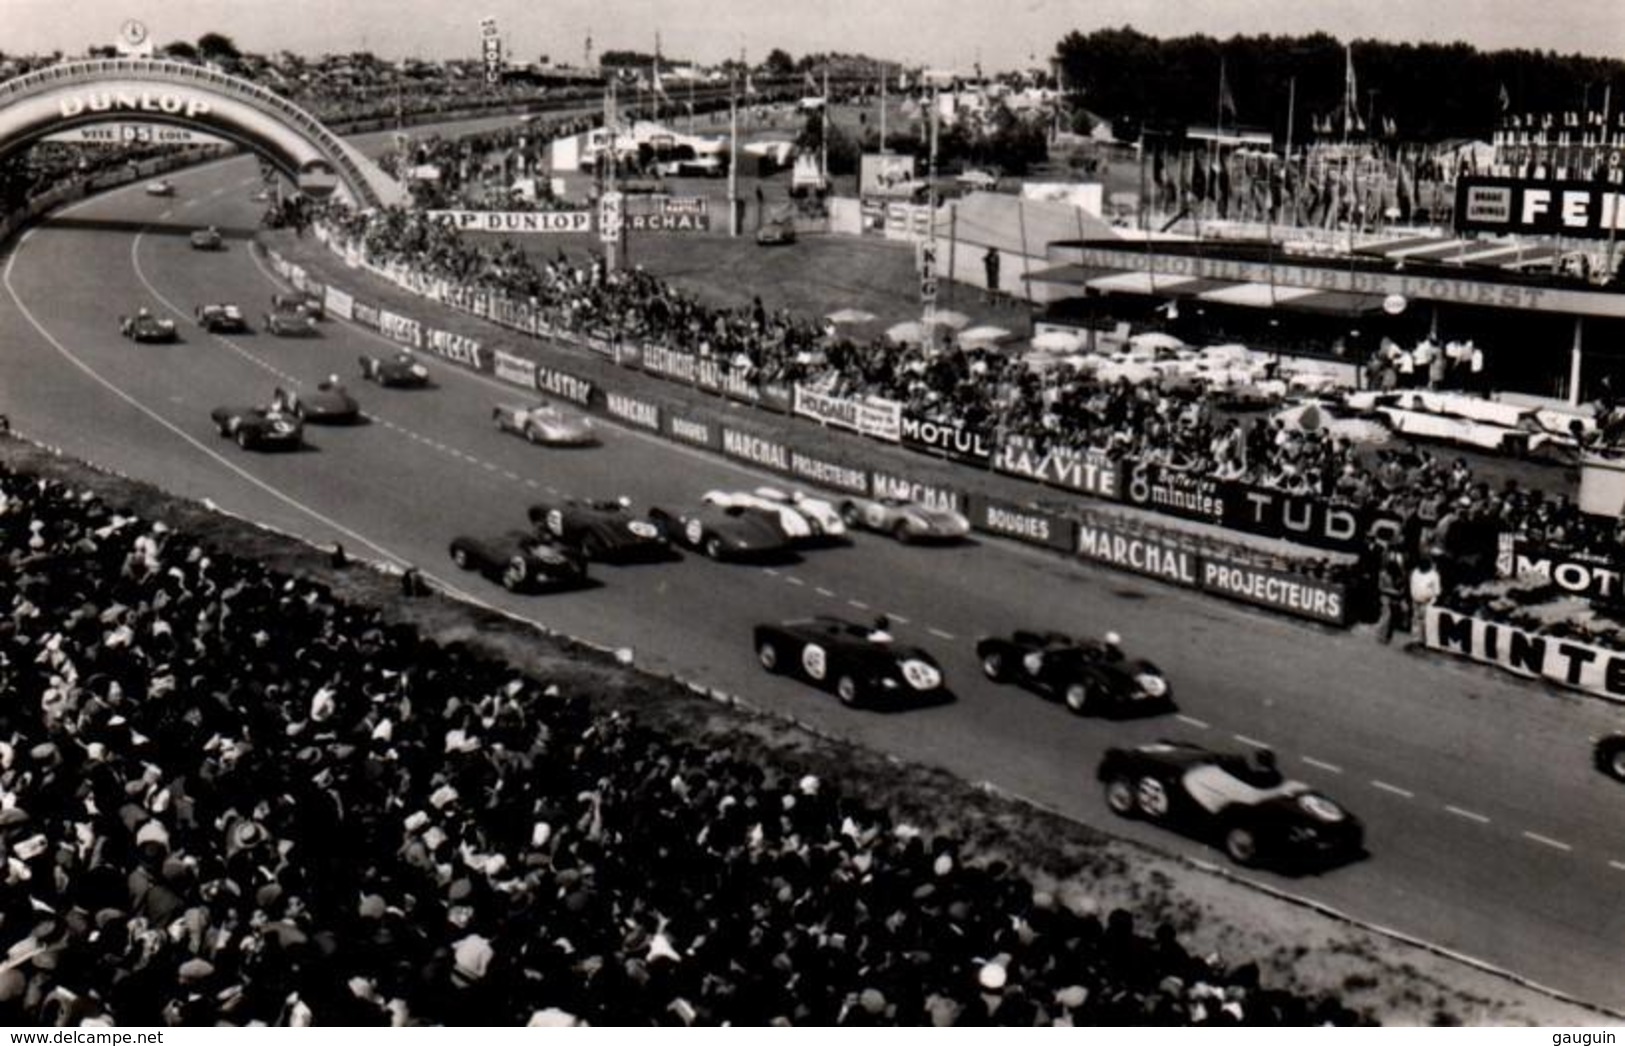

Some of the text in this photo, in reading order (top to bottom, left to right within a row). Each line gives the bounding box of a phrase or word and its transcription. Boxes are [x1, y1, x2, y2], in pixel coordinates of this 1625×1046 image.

[59, 92, 211, 118] DUNLOP
[488, 214, 586, 230] DUNLOP
[606, 393, 659, 430] MARCHAL
[902, 418, 990, 457] MOTUL
[723, 428, 868, 492] MARCHAL PROJECTEURS
[873, 472, 957, 513] MARCHAL
[1152, 485, 1224, 516] minutes
[986, 507, 1049, 540] BOUGIES
[1078, 525, 1340, 616] MARCHAL PROJECTEURS
